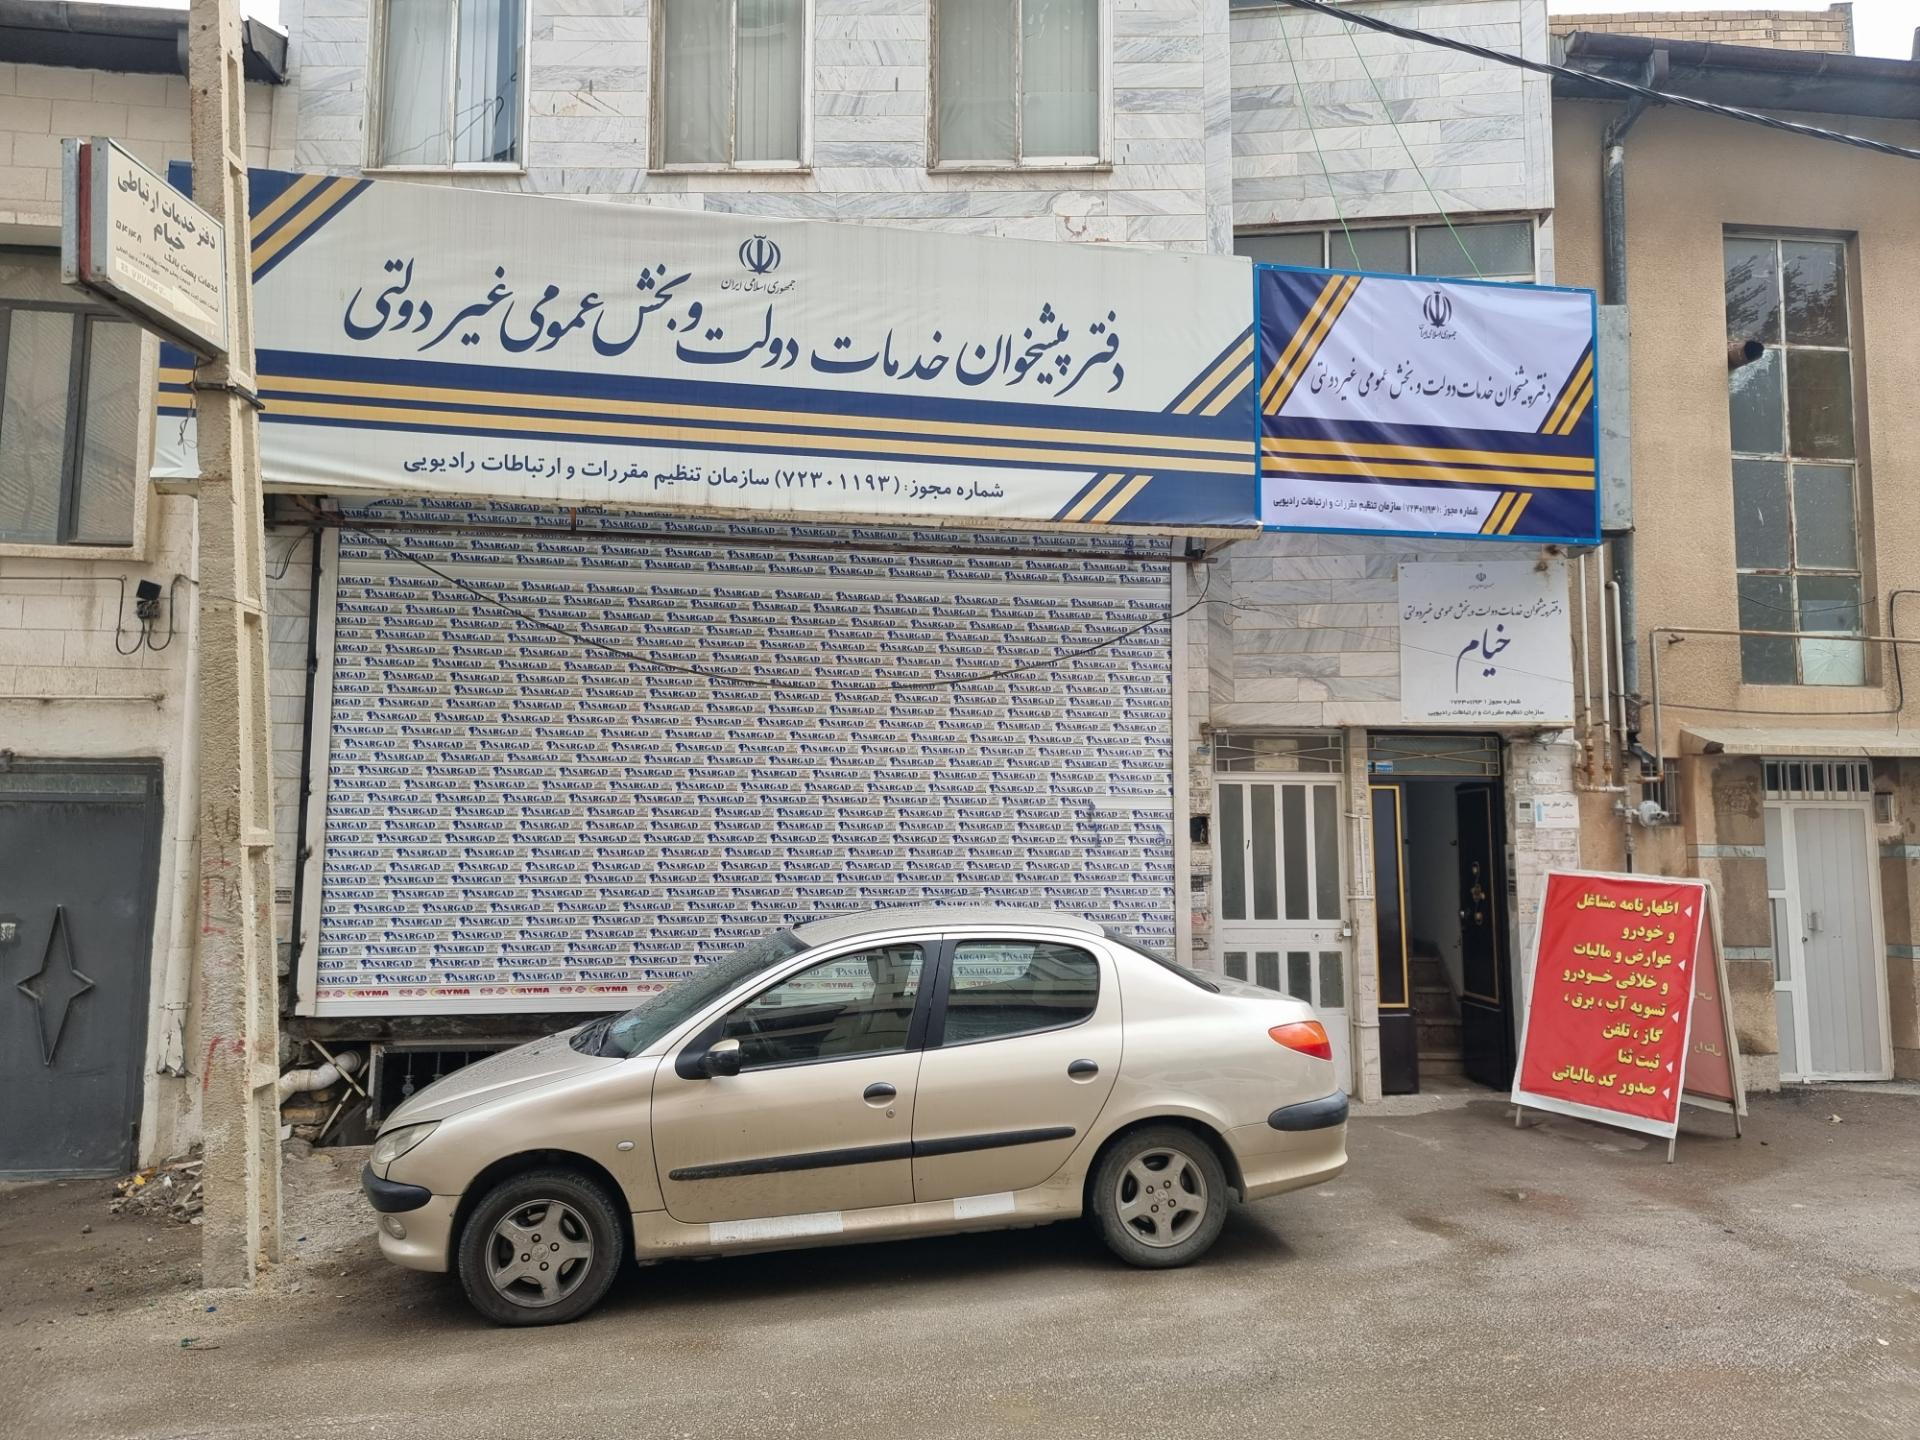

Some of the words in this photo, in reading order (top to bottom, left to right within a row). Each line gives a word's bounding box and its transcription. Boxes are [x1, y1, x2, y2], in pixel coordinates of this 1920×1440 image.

[117, 169, 159, 213] ارتباطی
[162, 201, 196, 233] خدمات
[154, 223, 185, 252] خیام
[196, 226, 215, 249] دفتر
[164, 253, 180, 270] بانک
[181, 264, 197, 282] پست
[198, 276, 218, 293] خدمات
[721, 279, 742, 291] ایران
[744, 278, 767, 291] اسلامی
[767, 279, 796, 294] جمهوری
[344, 257, 433, 340] دولتی
[417, 265, 513, 351] غیر
[592, 264, 692, 356] بخش
[680, 301, 703, 333] و
[500, 284, 604, 353] عمومی
[676, 303, 800, 370] دولت
[955, 302, 1071, 386] پیشخوان
[810, 328, 950, 381] خدمات
[1054, 310, 1125, 397] دفتر
[1311, 362, 1338, 394] دولتی
[1336, 357, 1357, 401] غیر
[1358, 369, 1388, 397] عمومی
[1390, 360, 1413, 400] بخش
[1422, 375, 1456, 397] دولت
[1495, 364, 1533, 407] پیشخوان
[1416, 382, 1421, 394] و
[1457, 375, 1493, 400] خدمات
[1528, 372, 1551, 408] دفتر
[404, 451, 475, 473] رادیویی
[481, 454, 561, 478] ارتباطات
[566, 466, 575, 480] و
[582, 460, 648, 483] مقررات
[654, 465, 702, 489] تنظیم
[707, 467, 769, 488] سازمان
[957, 481, 1004, 501] شماره
[1273, 496, 1299, 508] رادیویی
[1301, 496, 1327, 509] ارتباطات
[1335, 499, 1357, 510] مقررات
[1359, 500, 1377, 512] تنظیم
[1378, 501, 1400, 513] سازمان
[1460, 506, 1479, 517] شماره
[1434, 606, 1453, 620] عمومی
[1475, 605, 1498, 617] دولت
[1499, 604, 1523, 617] خدمات
[1455, 623, 1511, 694] خیام
[1576, 893, 1617, 910] مشاغل
[1621, 925, 1664, 942] خودرو
[1666, 931, 1676, 944] و
[366, 945, 416, 954] PASARGAD
[434, 944, 484, 953] PASARGAD
[501, 943, 551, 952] PASARGAD
[567, 942, 617, 951] PASARGAD
[634, 942, 681, 950] PASARGAD
[697, 941, 744, 949] PASARGAD
[1573, 942, 1612, 959] مالیات
[361, 959, 412, 968] PASARGAD
[429, 958, 480, 967] PASARGAD
[497, 957, 547, 966] PASARGAD
[564, 956, 613, 965] PASARGAD
[629, 955, 677, 964] PASARGAD
[1613, 951, 1623, 964] و
[1625, 949, 1672, 968] عوارض
[375, 974, 427, 983] PASARGAD
[445, 973, 495, 982] PASARGAD
[513, 972, 562, 981] PASARGAD
[580, 971, 628, 979] PASARGAD
[645, 970, 693, 978] PASARGAD
[1616, 971, 1657, 990] خلافی
[1659, 982, 1669, 995] و
[1630, 1002, 1667, 1019] تسویه
[1602, 1022, 1631, 1039] تلفن
[1640, 1027, 1664, 1045] گاز
[1617, 1048, 1633, 1064] ثنا
[1635, 1053, 1661, 1072] ثبت
[1551, 1065, 1596, 1083] مالیاتی
[1598, 1074, 1617, 1087] کد
[1618, 1081, 1656, 1095] صدور
